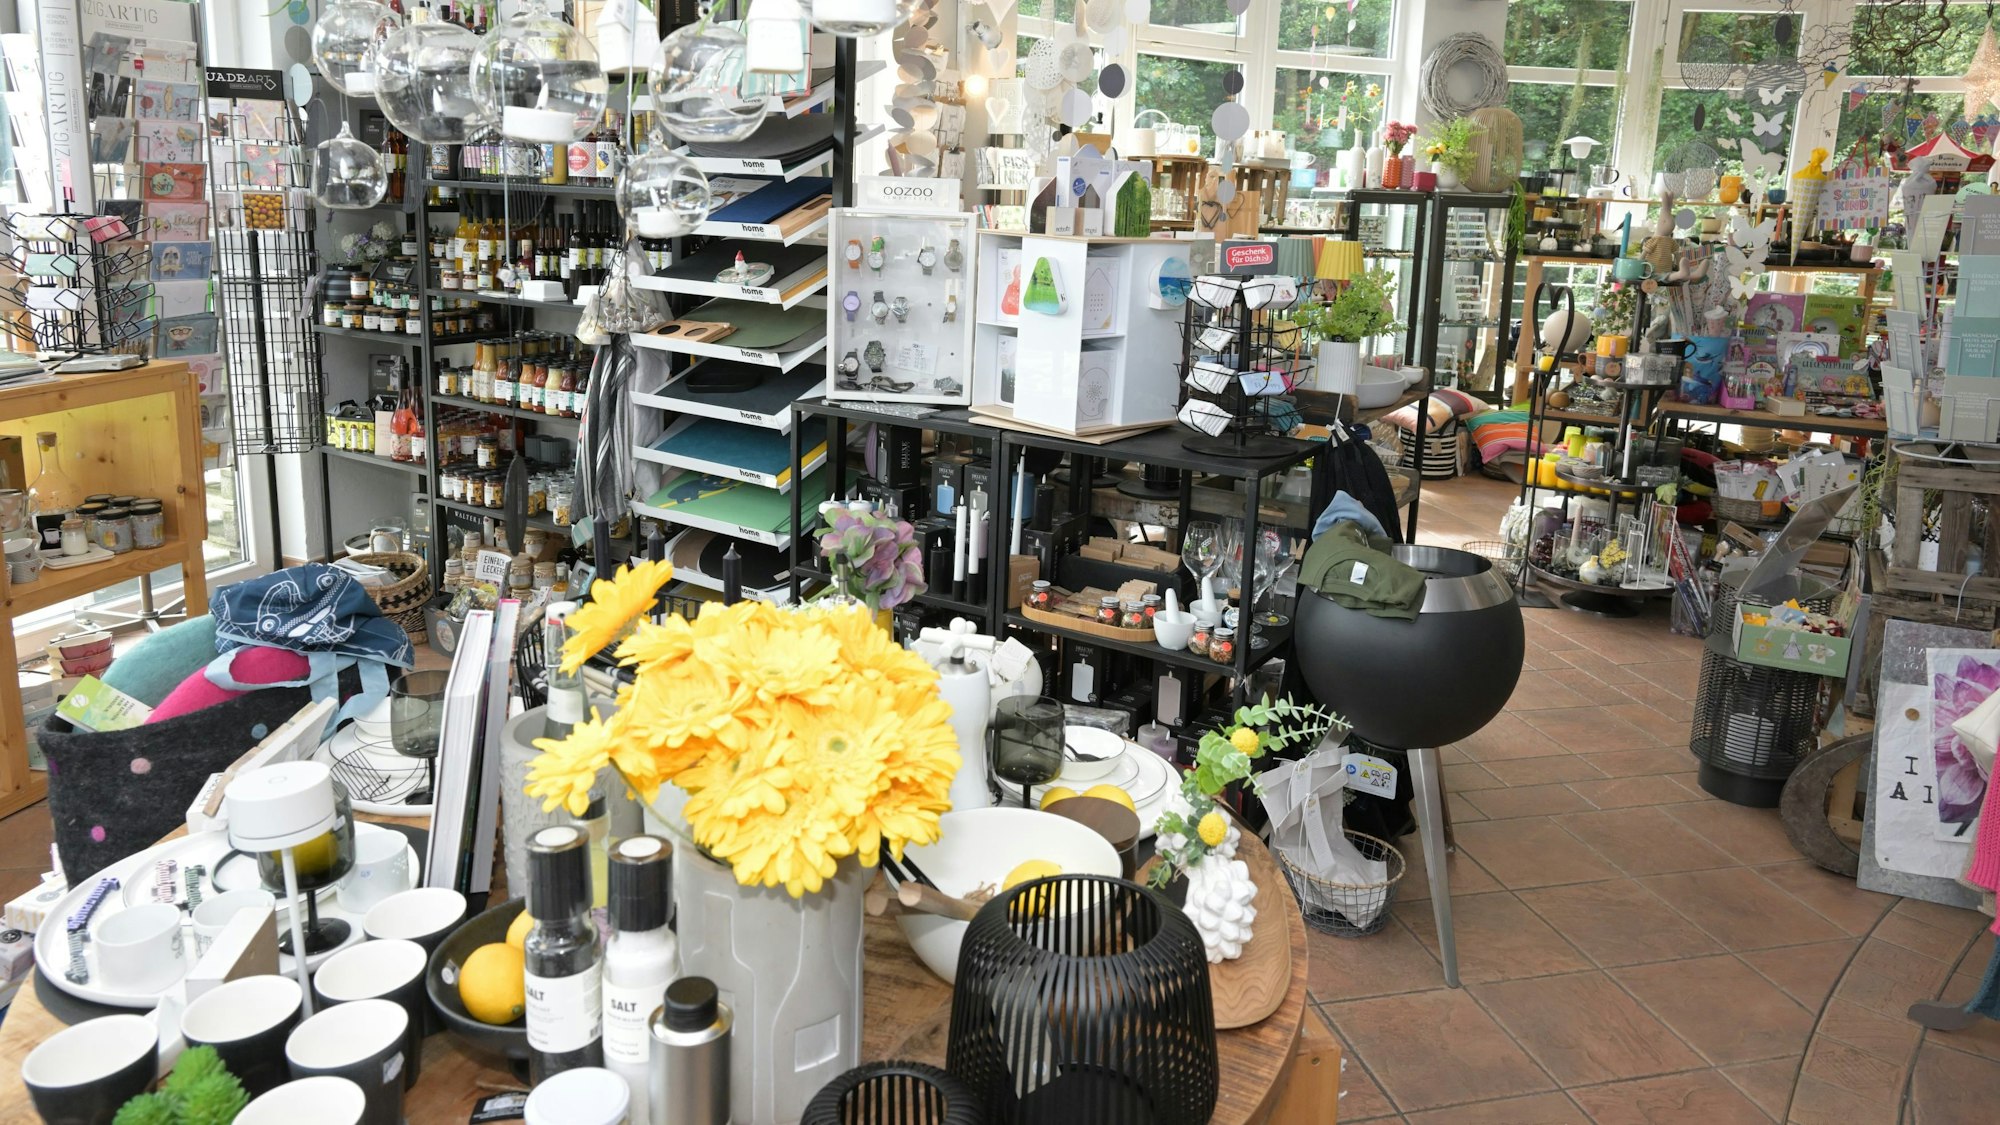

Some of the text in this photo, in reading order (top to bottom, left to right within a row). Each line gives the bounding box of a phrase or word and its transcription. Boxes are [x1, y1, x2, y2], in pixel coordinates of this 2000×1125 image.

[742, 160, 765, 168] home
[883, 186, 933, 197] OOZOO
[742, 224, 764, 232] home
[1231, 248, 1266, 257] Geschenk
[741, 287, 763, 296] home
[741, 349, 763, 359] home
[740, 411, 762, 421] home
[740, 470, 761, 480] home
[938, 467, 954, 475] DELUXE
[454, 511, 477, 522] WALTER
[739, 526, 760, 537] home
[611, 998, 637, 1012] SALT
